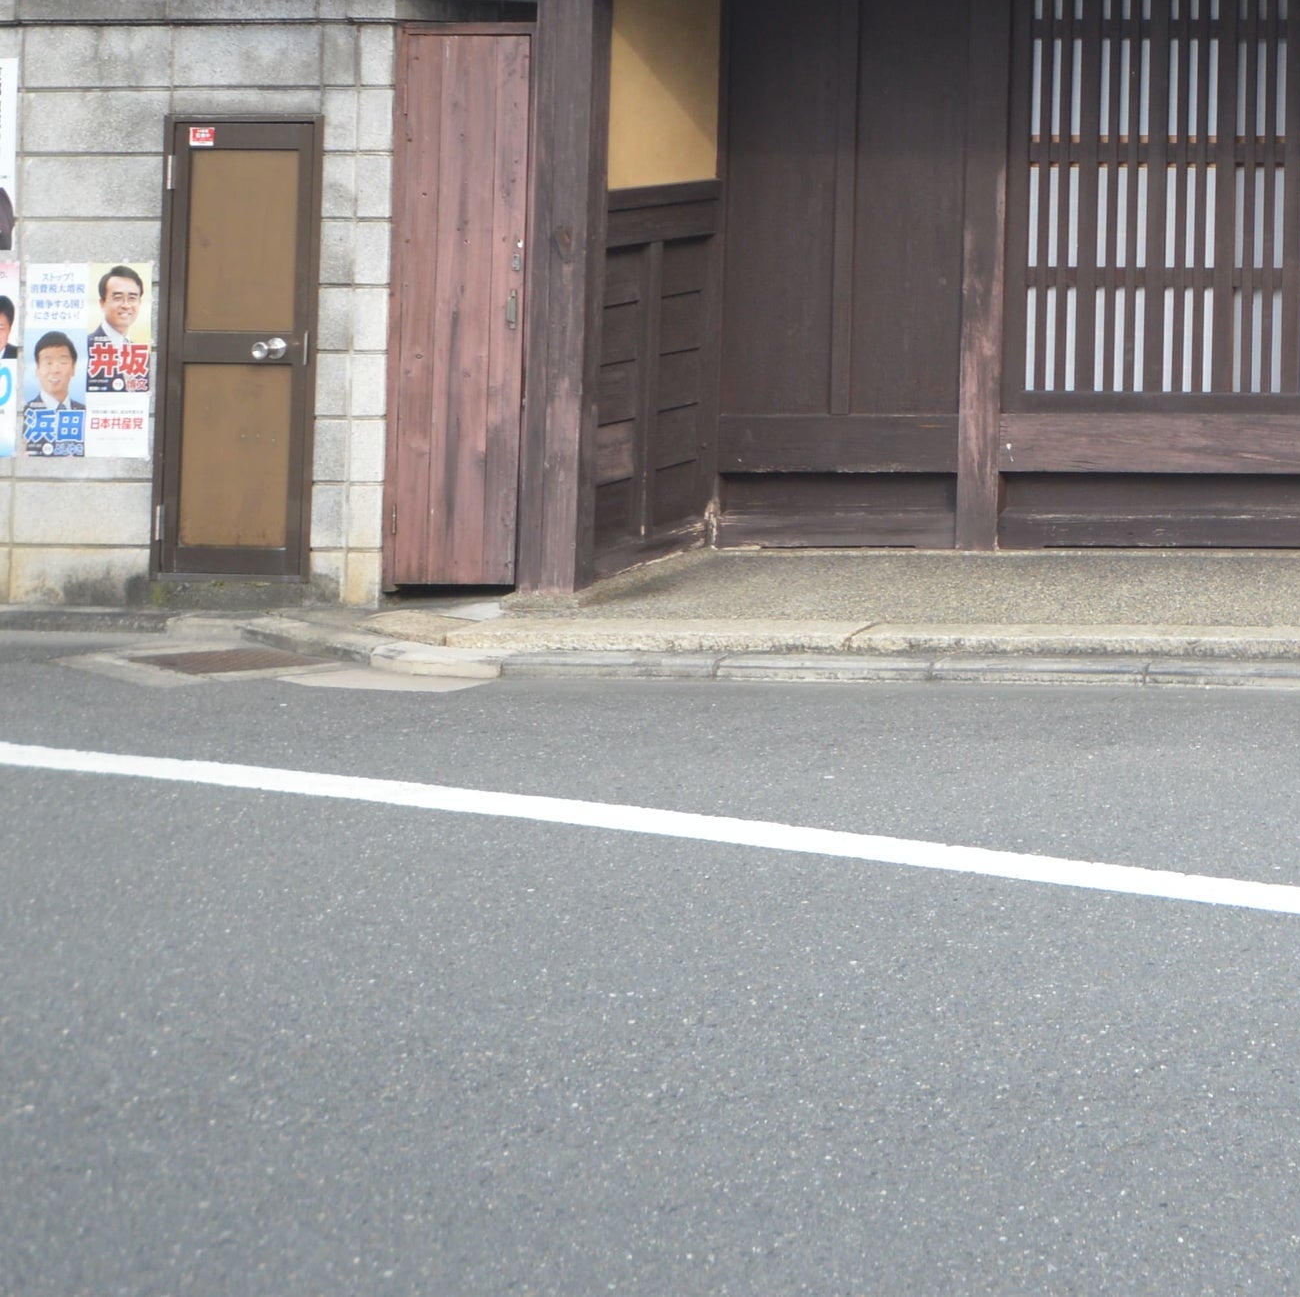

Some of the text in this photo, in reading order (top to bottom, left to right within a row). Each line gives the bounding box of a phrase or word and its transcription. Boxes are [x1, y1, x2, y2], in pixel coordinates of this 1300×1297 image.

[89, 343, 149, 377] 井坂
[23, 408, 85, 442] 浜田
[91, 417, 143, 430] 日本共産党
